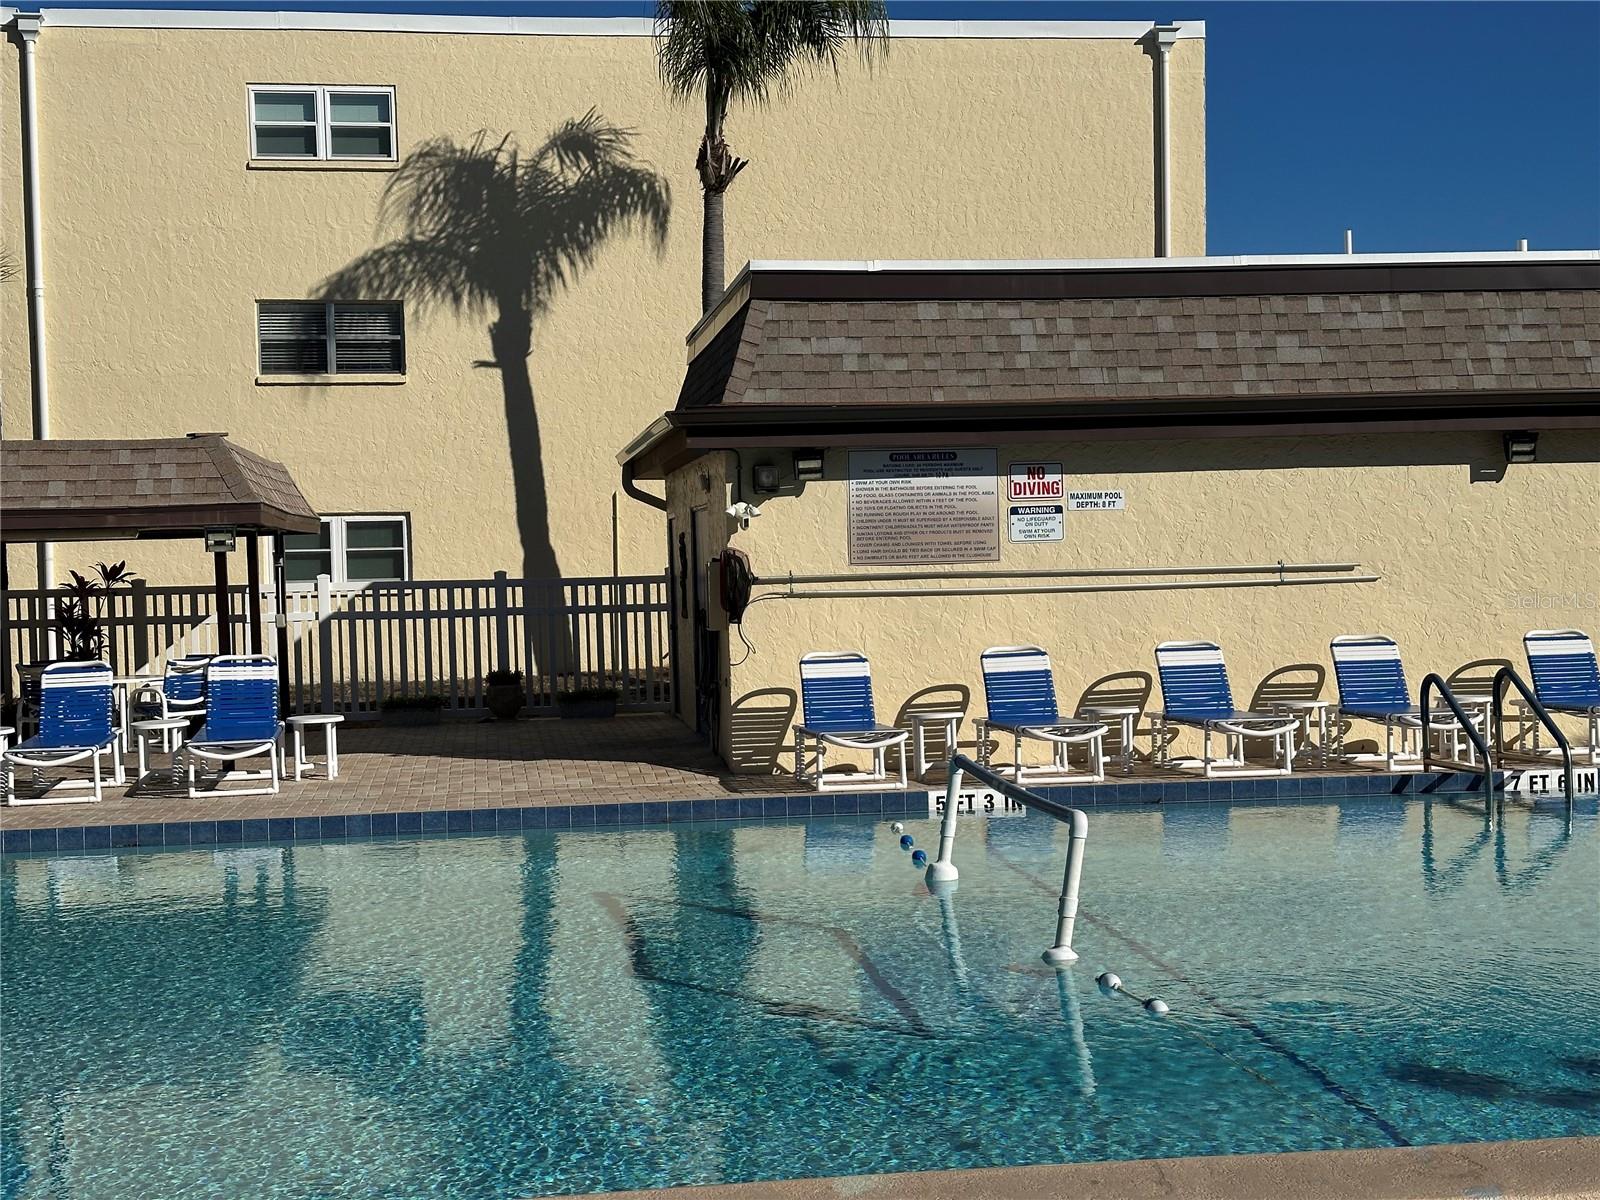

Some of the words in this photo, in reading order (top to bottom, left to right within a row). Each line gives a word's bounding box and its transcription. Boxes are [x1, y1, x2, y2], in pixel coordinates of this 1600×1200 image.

[1027, 466, 1045, 480] NO
[1014, 481, 1060, 496] DIVING
[1511, 776, 1520, 790] 7
[1530, 775, 1549, 792] FT
[1578, 773, 1594, 792] IN
[936, 796, 946, 811] 5
[984, 794, 994, 812] 3
